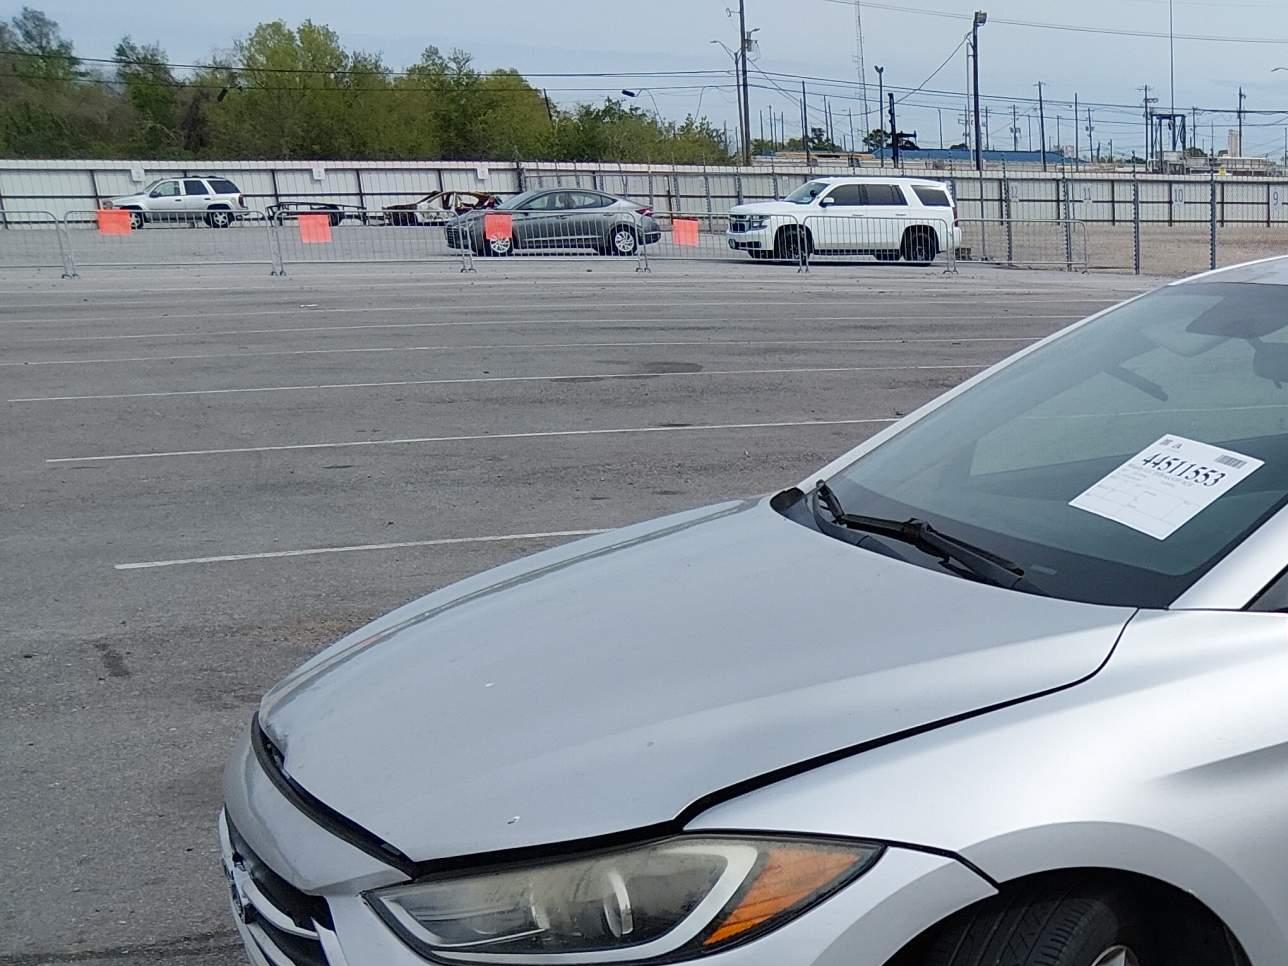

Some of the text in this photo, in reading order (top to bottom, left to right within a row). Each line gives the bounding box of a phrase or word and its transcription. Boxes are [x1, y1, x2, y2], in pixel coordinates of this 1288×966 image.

[1173, 188, 1184, 203] 10
[1272, 191, 1279, 206] 9
[1142, 453, 1226, 487] 44511553
